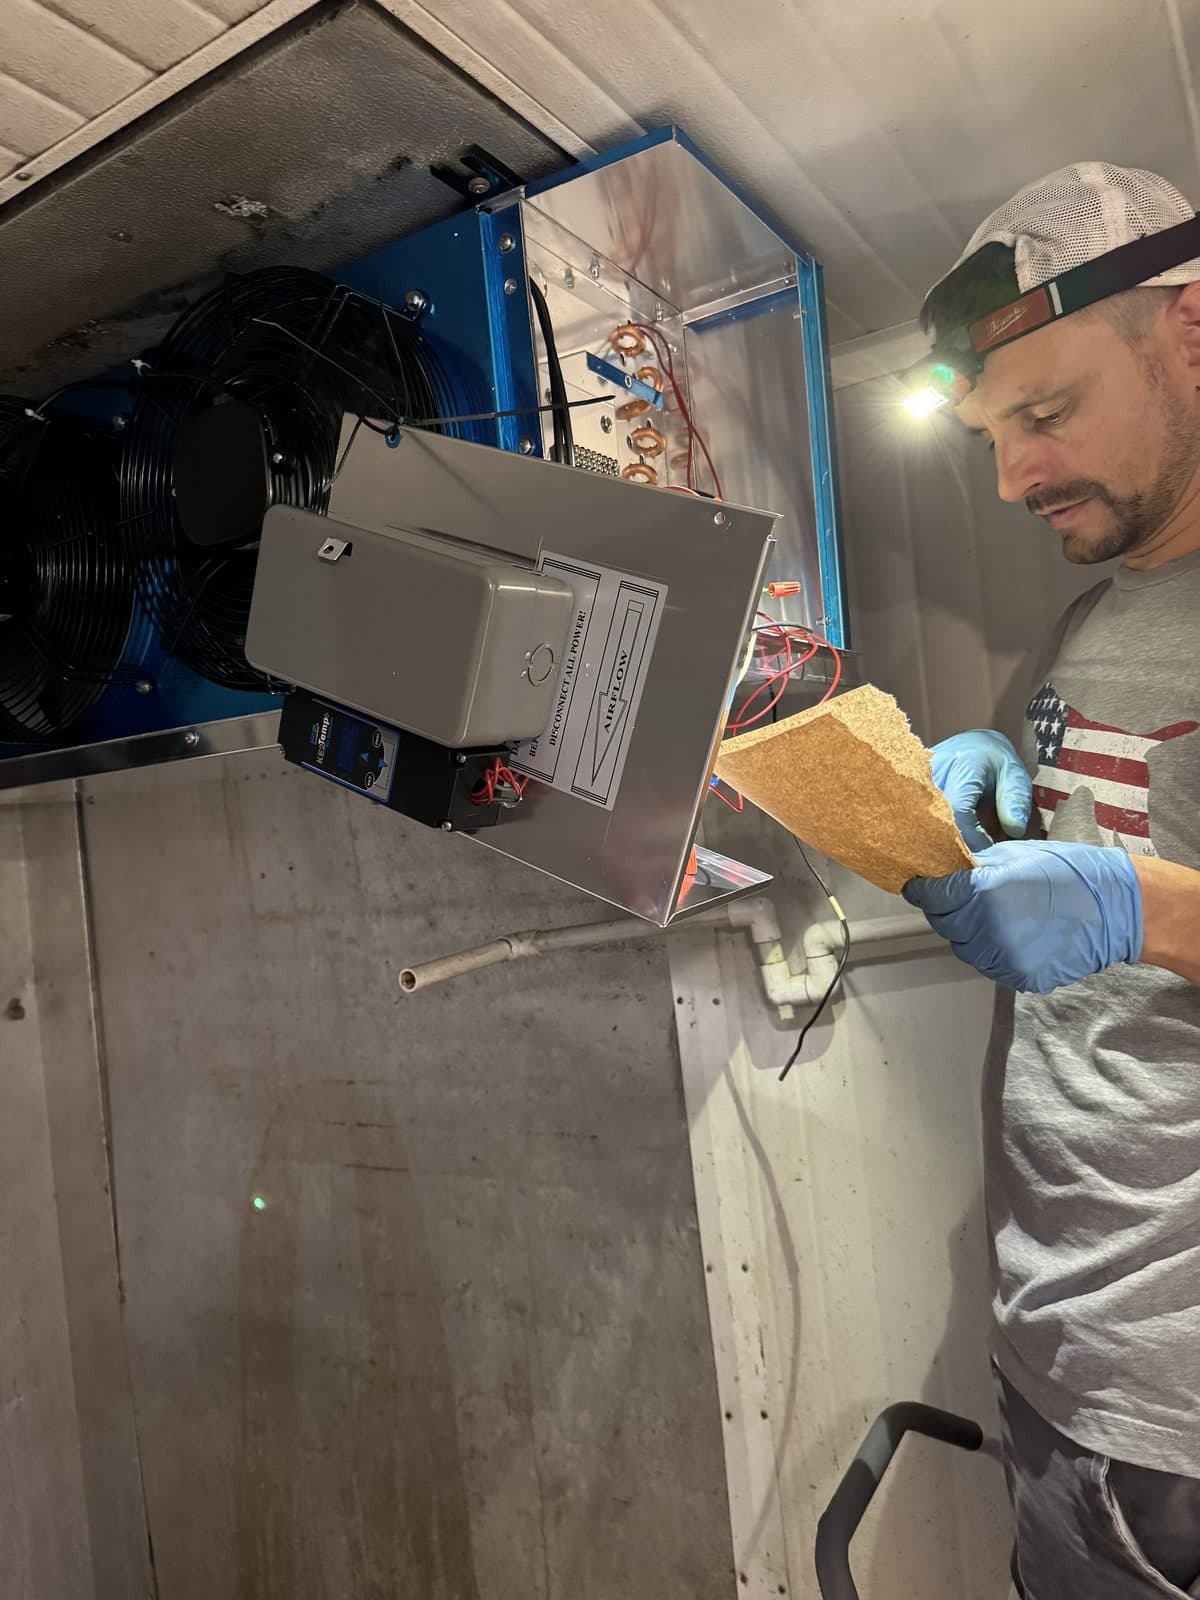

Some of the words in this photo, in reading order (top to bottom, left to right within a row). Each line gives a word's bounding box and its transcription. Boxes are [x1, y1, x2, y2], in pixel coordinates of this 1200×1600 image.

[570, 609, 586, 655] POWER!
[565, 656, 576, 678] ALL
[604, 650, 628, 734] AIRFLOW
[549, 679, 570, 746] DISCONNECT
